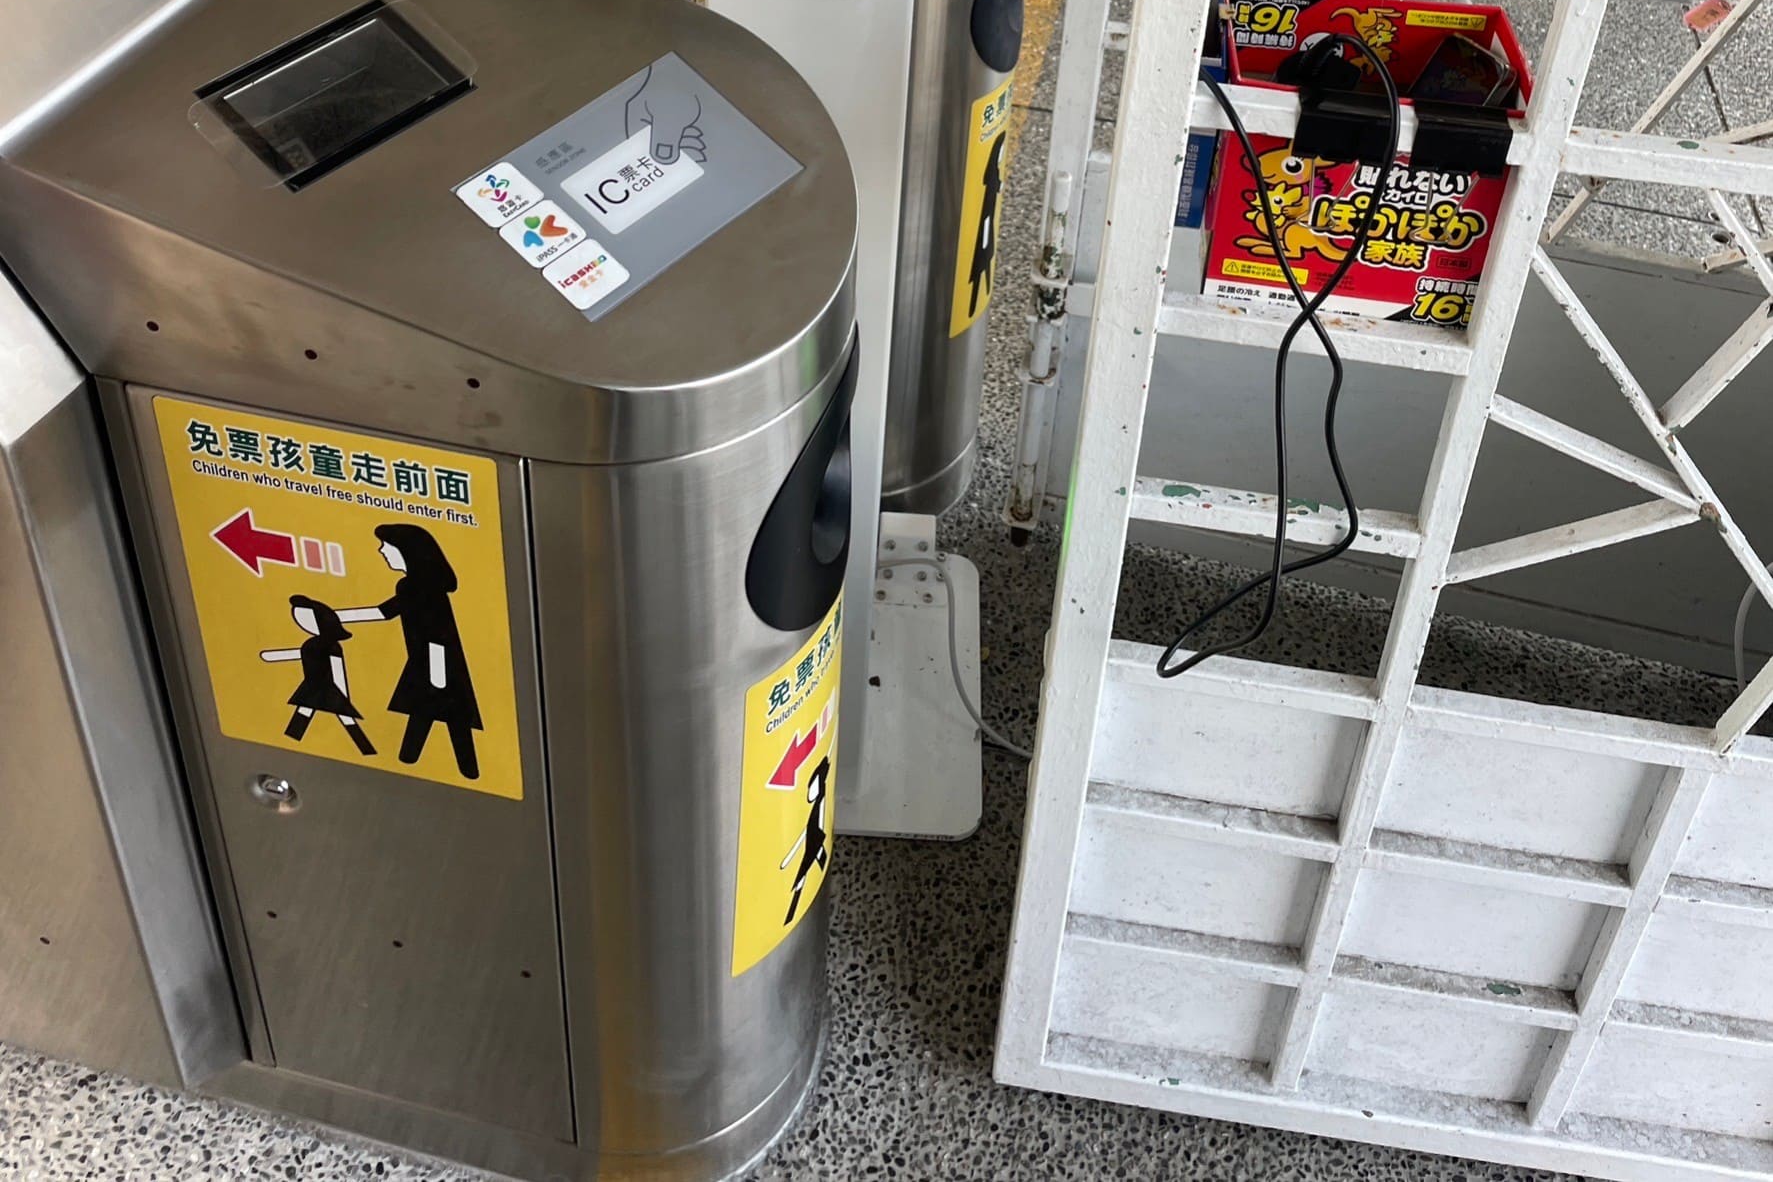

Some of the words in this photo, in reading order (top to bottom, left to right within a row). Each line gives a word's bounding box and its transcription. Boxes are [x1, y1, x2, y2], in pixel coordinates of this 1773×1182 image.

[617, 156, 653, 183] 票卡
[584, 179, 630, 214] IC
[632, 165, 665, 192] card
[1385, 189, 1428, 204] カイロ
[536, 245, 559, 262] iPASS
[1365, 240, 1425, 268] 家族
[186, 420, 471, 505] 免票孩童走前面
[192, 459, 249, 482] Children
[253, 471, 281, 488] who
[284, 477, 323, 496] travel
[326, 485, 353, 502] free
[356, 491, 403, 512] should
[407, 504, 442, 521] enter
[446, 509, 478, 527] first.
[766, 696, 803, 733] Children
